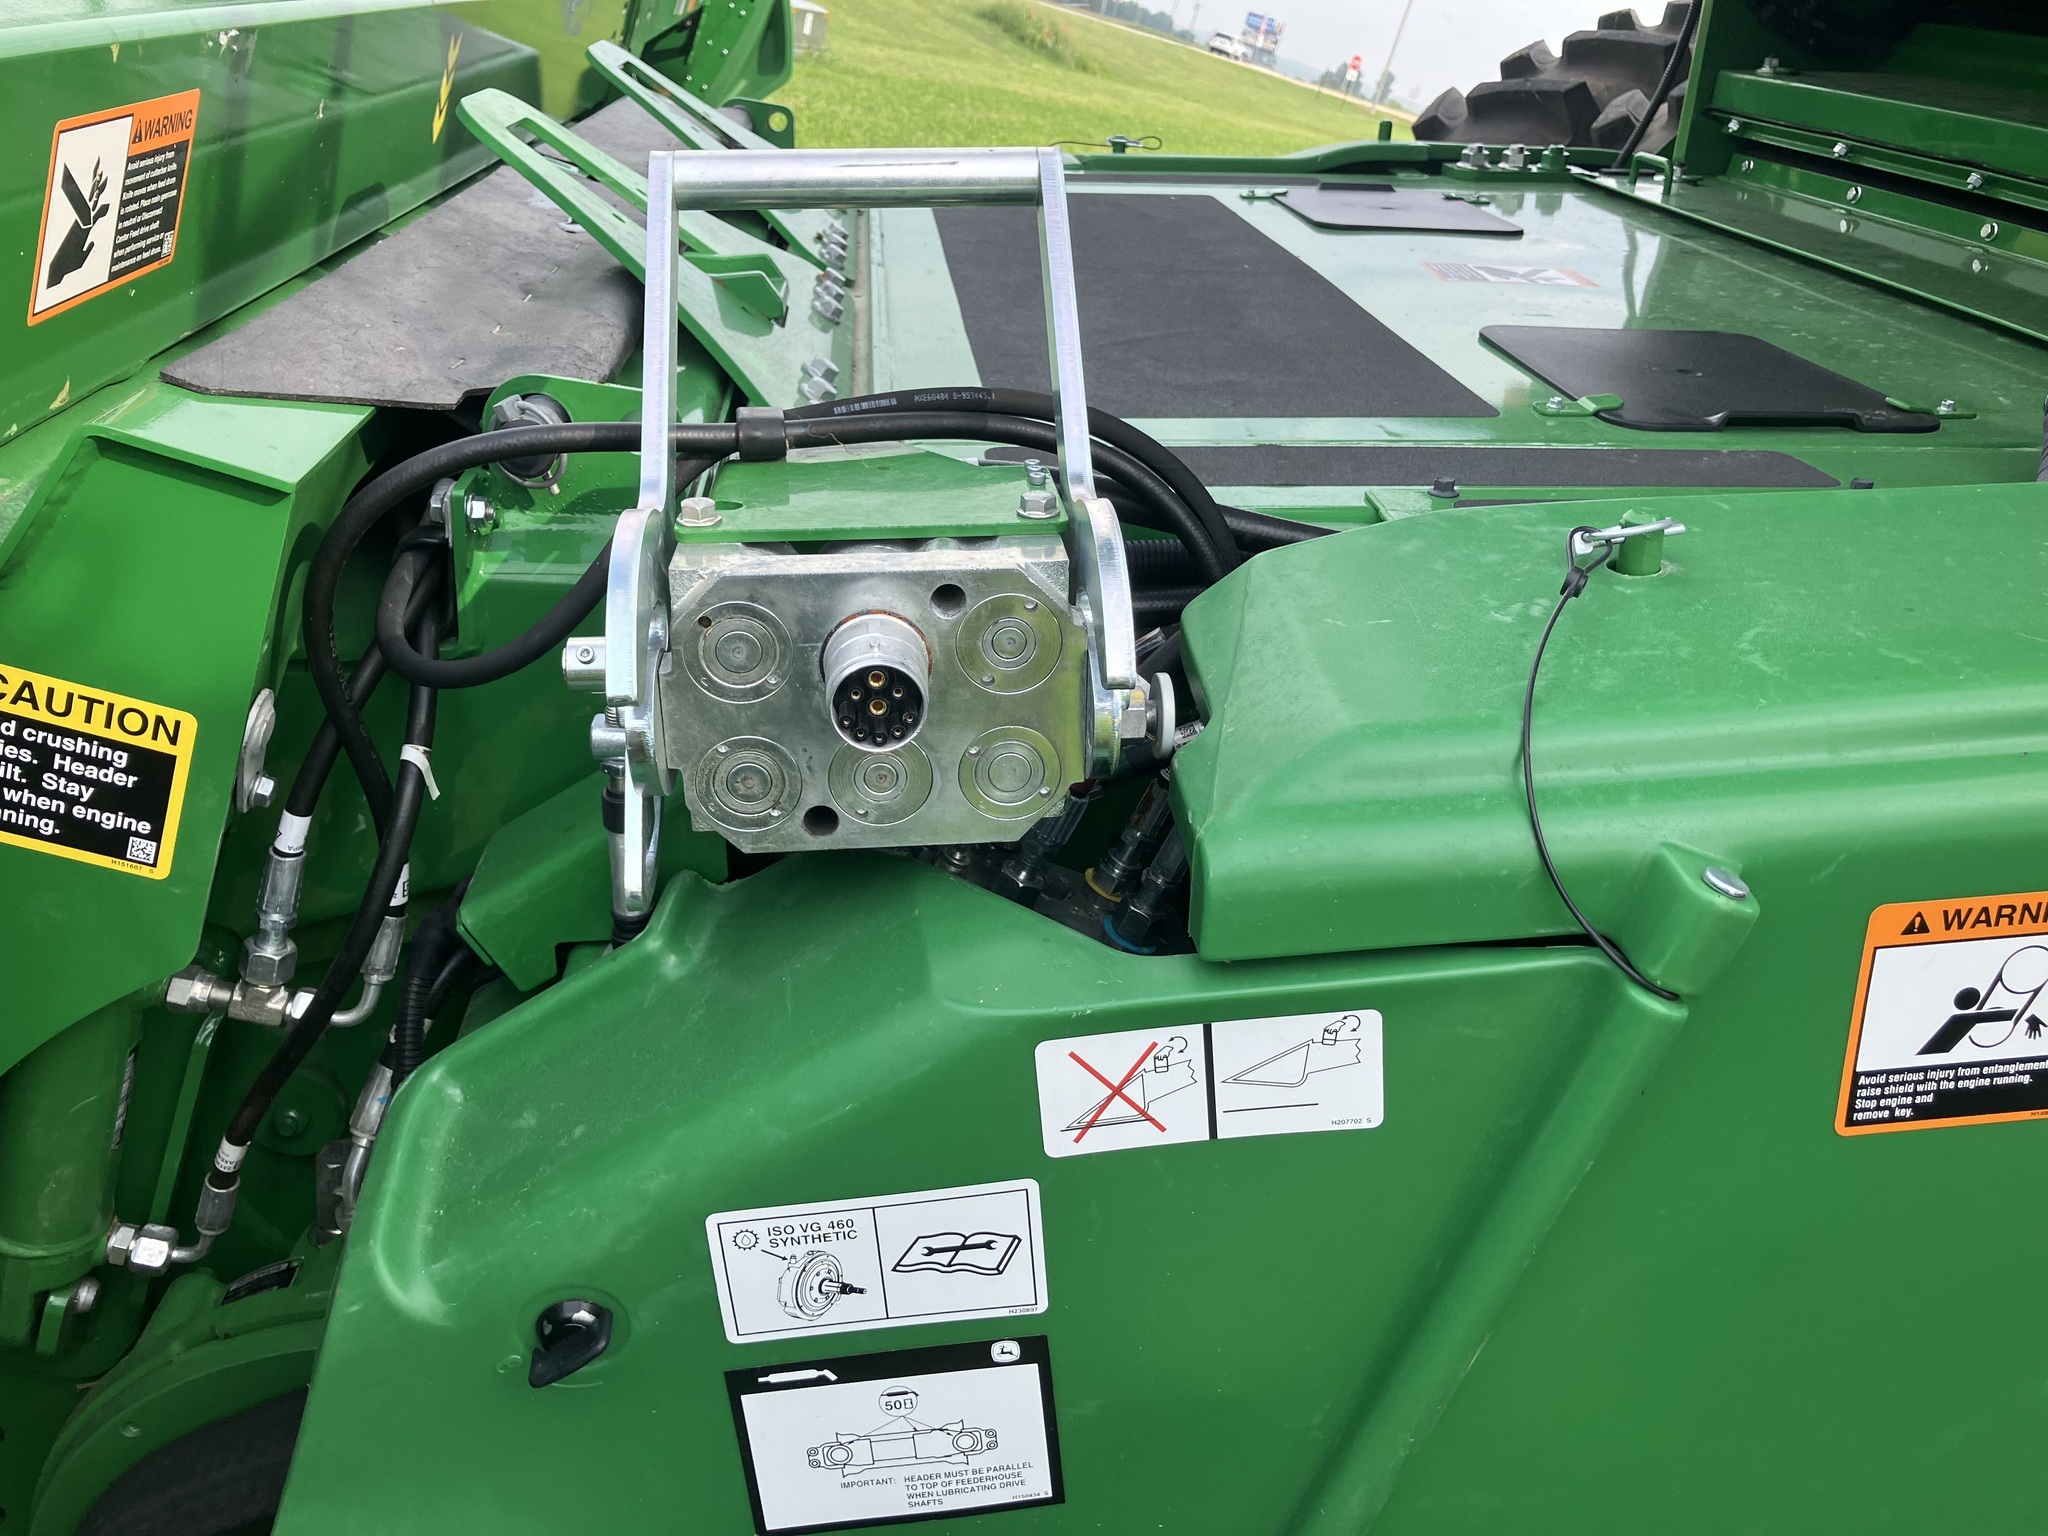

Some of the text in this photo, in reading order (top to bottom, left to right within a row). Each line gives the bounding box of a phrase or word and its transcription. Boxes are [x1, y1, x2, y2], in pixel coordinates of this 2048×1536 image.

[143, 109, 193, 142] WARNING
[140, 157, 153, 166] serious
[155, 153, 165, 164] injury
[166, 150, 174, 158] from
[147, 183, 157, 191] when
[140, 198, 150, 207] Place
[123, 216, 136, 227] neutral
[142, 207, 162, 220] Disconnect
[116, 233, 128, 243] Center
[129, 229, 139, 238] Feed
[140, 225, 149, 233] drive
[113, 248, 124, 257] when
[125, 240, 145, 254] performing
[147, 234, 159, 244] service
[111, 257, 136, 271] maintenance
[142, 250, 150, 258] feed
[23, 727, 129, 768] crushing
[53, 753, 138, 788] Header
[41, 773, 94, 802] Stay
[3, 788, 152, 834] when engine
[111, 859, 143, 871] H151607
[1856, 1073, 2033, 1098] raise shield with the engine running.
[1858, 1075, 1886, 1086] Avoid
[1888, 1072, 1924, 1083] serious
[1926, 1069, 1955, 1081] injury
[1957, 1066, 1980, 1076] from
[1855, 1092, 1933, 1111] Stop engine and
[1853, 1106, 1914, 1121] remove key.
[768, 1219, 855, 1237] ISO VG 460
[769, 1230, 858, 1249] SYNTHETIC
[885, 1400, 902, 1411] 50
[840, 1461, 1034, 1489] IMPORTANT: HEADER MUST BE PARALLEL
[919, 1482, 938, 1490] TOP
[940, 1480, 953, 1489] OF
[955, 1472, 1023, 1487] FEEDERHOUSE
[906, 1479, 1026, 1500] WHEN LUBRICATING DRIVE
[907, 1498, 943, 1508] SHAFTS
